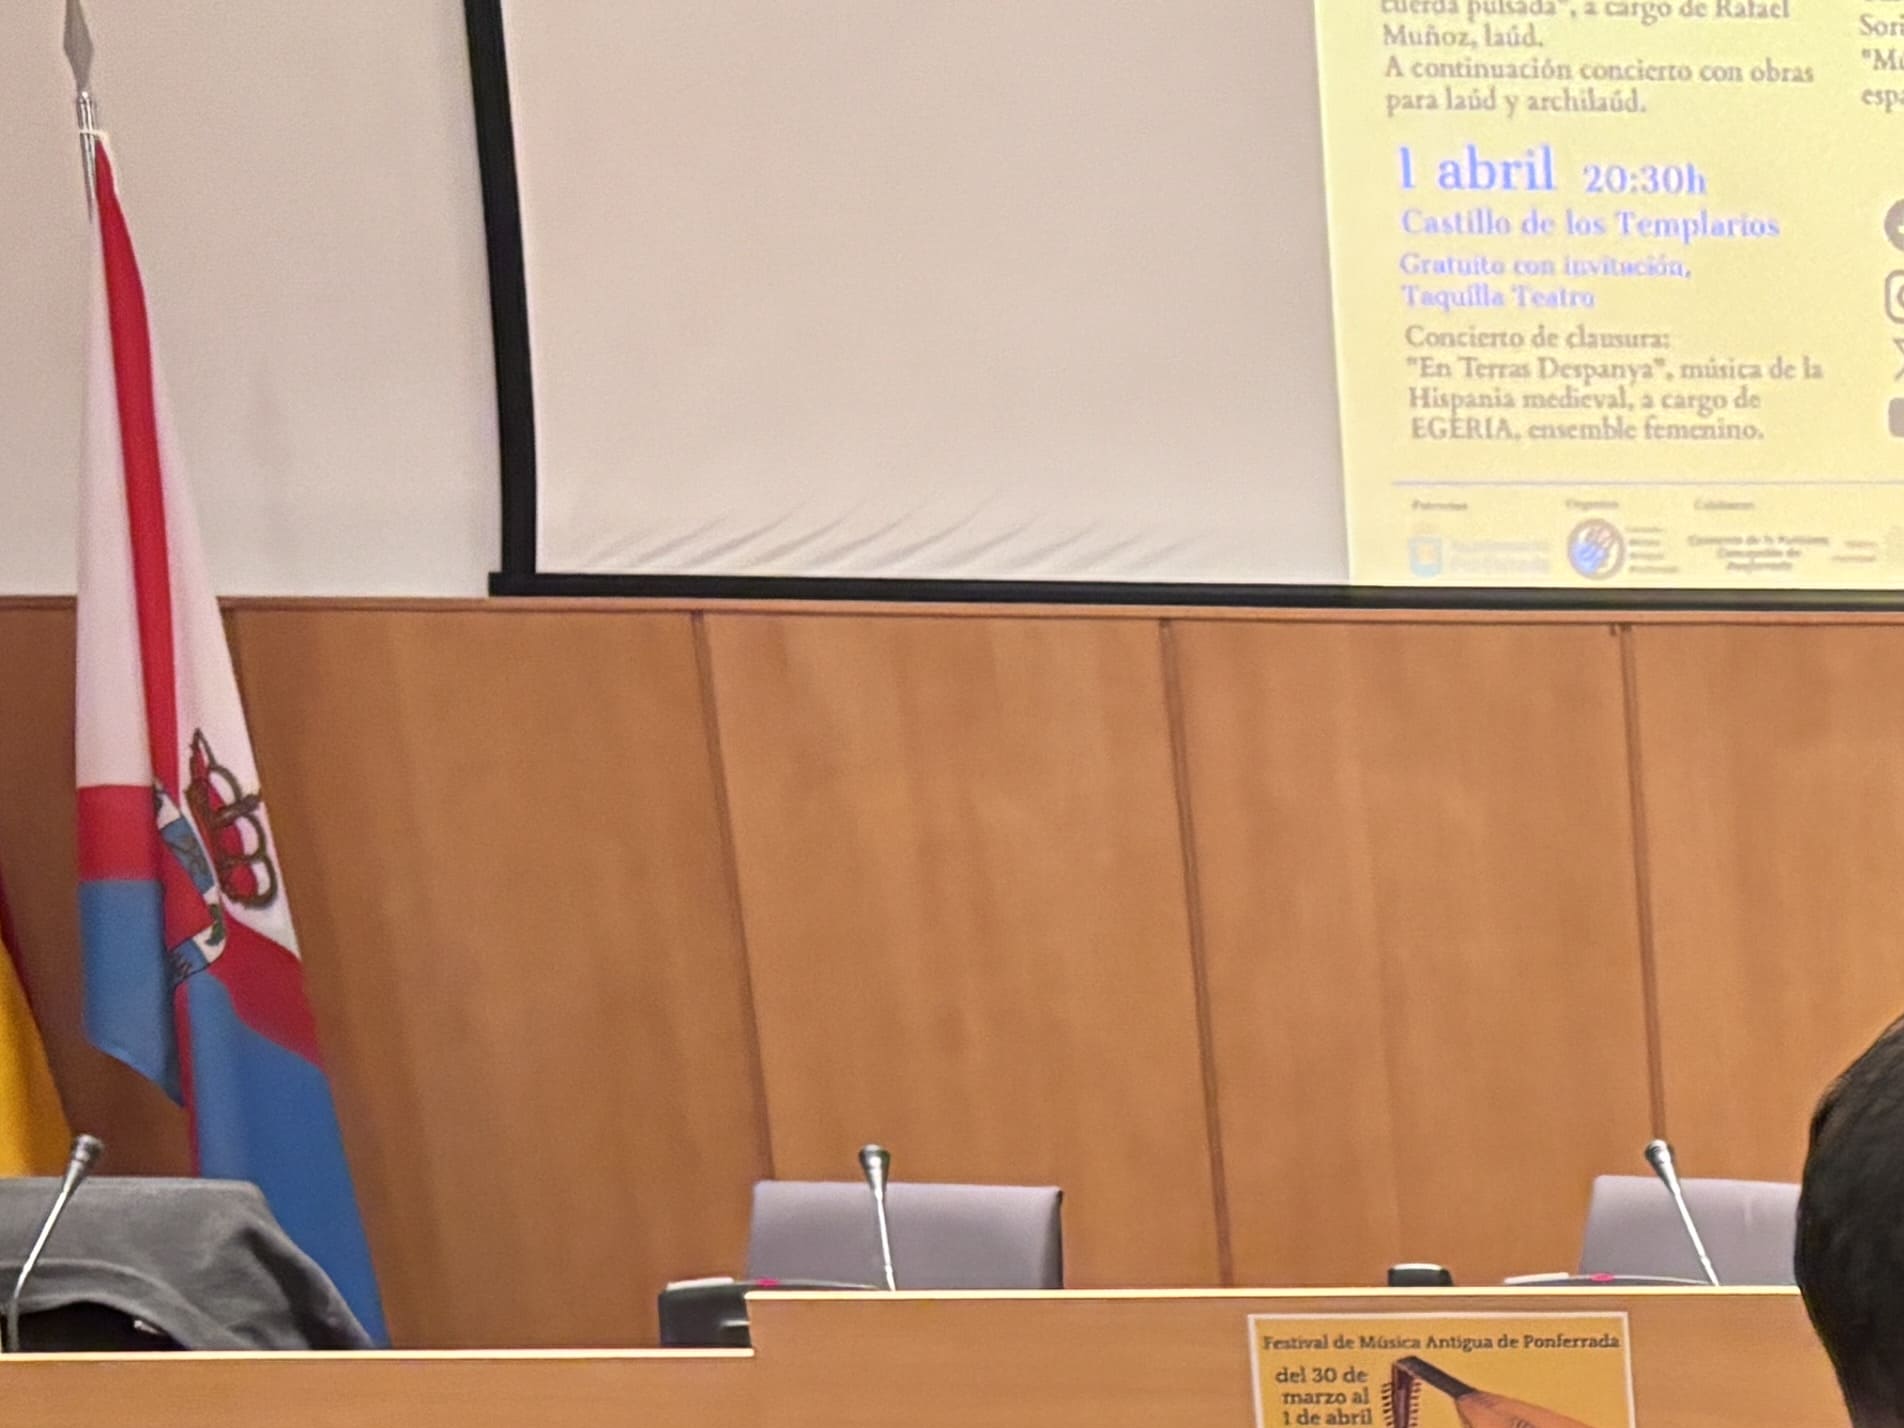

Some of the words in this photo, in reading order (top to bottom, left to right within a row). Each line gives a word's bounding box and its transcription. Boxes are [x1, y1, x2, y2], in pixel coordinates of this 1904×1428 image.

[1604, 0, 1672, 26] cargo
[1383, 23, 1478, 48] Muñoz,
[1485, 22, 1544, 47] laúd.
[1385, 57, 1404, 79] A
[1411, 59, 1572, 81] continuación
[1579, 60, 1693, 83] concierto
[1699, 63, 1744, 83] con
[1750, 58, 1814, 84] obras
[1387, 92, 1438, 118] para
[1446, 86, 1497, 112] laúd
[1506, 93, 1519, 117] y
[1526, 87, 1647, 114] archilaúd.
[1437, 143, 1556, 191] abril
[1583, 162, 1707, 195] 20:30h
[1401, 209, 1511, 236] Castillo
[1521, 209, 1555, 236] de
[1566, 209, 1606, 236] los
[1615, 209, 1781, 245] Templarios
[1400, 252, 1506, 277] Gratuito
[1514, 257, 1556, 277] con
[1401, 283, 1505, 313] Taquilla
[1512, 283, 1596, 308] Teatro
[1404, 324, 1525, 349] Concierto
[1531, 324, 1559, 349] de
[1565, 324, 1670, 349] clausura:
[1458, 356, 1531, 380] Terras
[1680, 356, 1762, 380] música
[1769, 357, 1798, 380] de
[1802, 356, 1823, 380] la
[1408, 386, 1516, 416] Hispania
[1522, 386, 1635, 412] medieval,
[1642, 392, 1655, 410] a
[1661, 393, 1728, 417] cargo
[1734, 386, 1761, 410] de
[1528, 416, 1637, 441] ensemble
[1643, 416, 1765, 441] femenino.
[1263, 1335, 1329, 1350] Festival
[1333, 1335, 1355, 1350] de
[1360, 1334, 1421, 1350] Música
[1426, 1335, 1493, 1352] Antigua
[1497, 1334, 1519, 1349] de
[1524, 1334, 1621, 1349] Ponferrada
[1275, 1367, 1308, 1384] del
[1312, 1368, 1337, 1384] 30
[1343, 1367, 1368, 1384] de
[1282, 1391, 1347, 1406] marzo
[1351, 1388, 1370, 1406] al
[1296, 1409, 1322, 1426] de
[1325, 1408, 1373, 1426] abril
